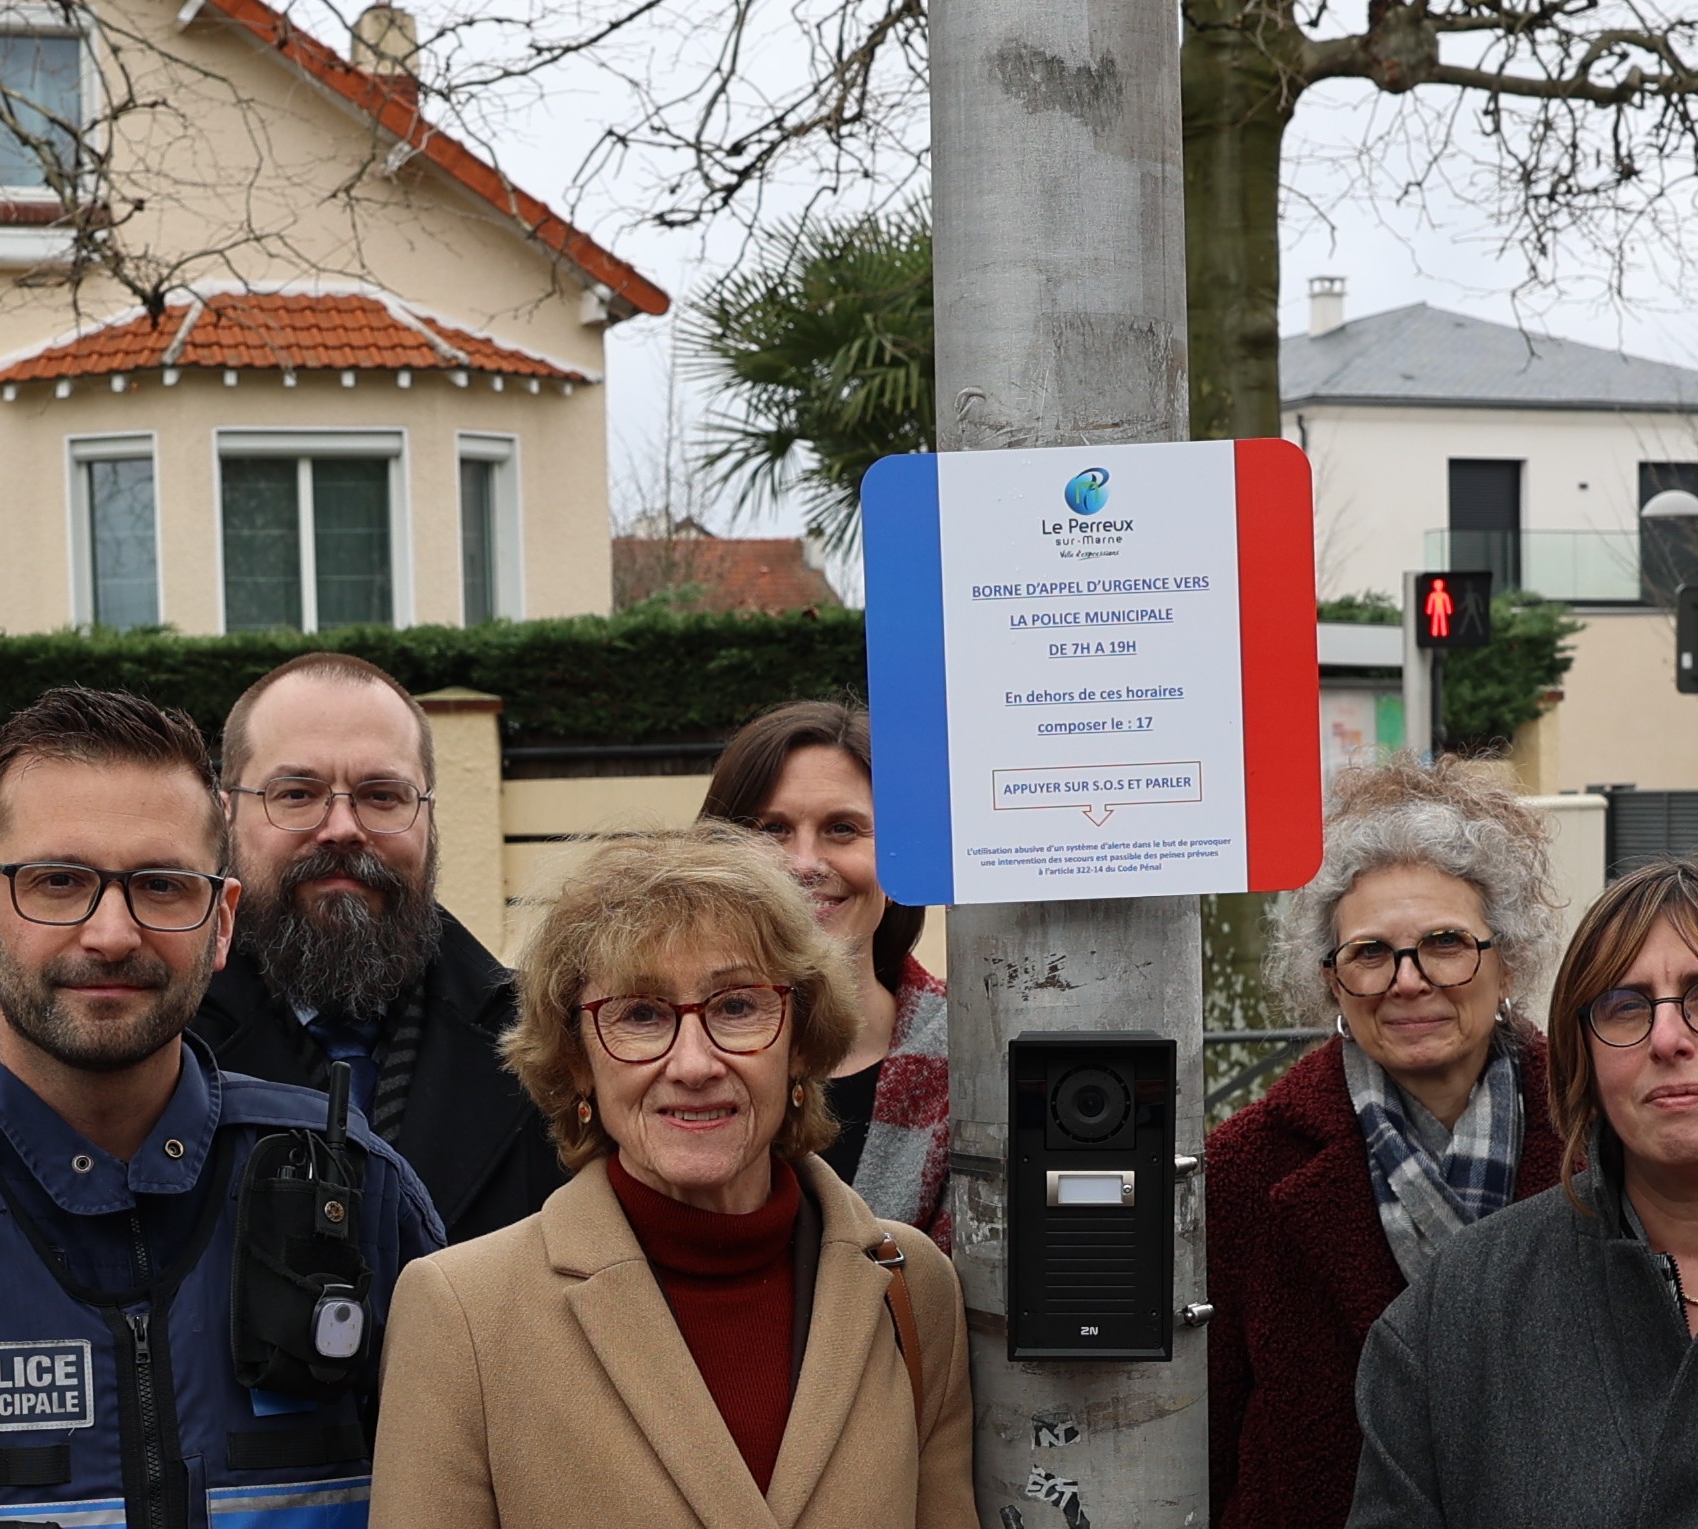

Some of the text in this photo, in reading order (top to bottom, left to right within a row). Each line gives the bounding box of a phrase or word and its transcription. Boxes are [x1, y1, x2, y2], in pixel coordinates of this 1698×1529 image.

[1042, 518, 1134, 535] Le Perreux
[1055, 535, 1123, 546] sur-Marne
[972, 575, 1209, 598] BORNE D'APPEL D'URGENCE VERS
[1010, 608, 1173, 627] LA POLICE MUNICIPALE
[1049, 640, 1137, 656] DE 7H A 19H
[1005, 685, 1183, 704] En dehors de ces horaires
[1037, 720, 1107, 735] composer
[1111, 717, 1123, 730] le
[1136, 716, 1153, 729] 17
[1003, 776, 1191, 796] APPUYER SUR S.O.S ET PARLER
[966, 838, 1232, 856] L'utilisation abusive d'un système d'alerte dans le but de provoquer
[997, 856, 1047, 866] intervention
[1048, 854, 1062, 863] des
[1064, 855, 1094, 863] secours
[1109, 852, 1142, 862] passible
[1144, 851, 1158, 860] des
[1159, 850, 1185, 861] peines
[1187, 849, 1219, 860] prévues
[1045, 866, 1074, 875] l'article
[1076, 865, 1103, 874] 322-14
[1105, 864, 1116, 873] du
[1117, 863, 1138, 873] Code
[1139, 862, 1162, 871] Pénal
[1081, 1326, 1098, 1335] 2N
